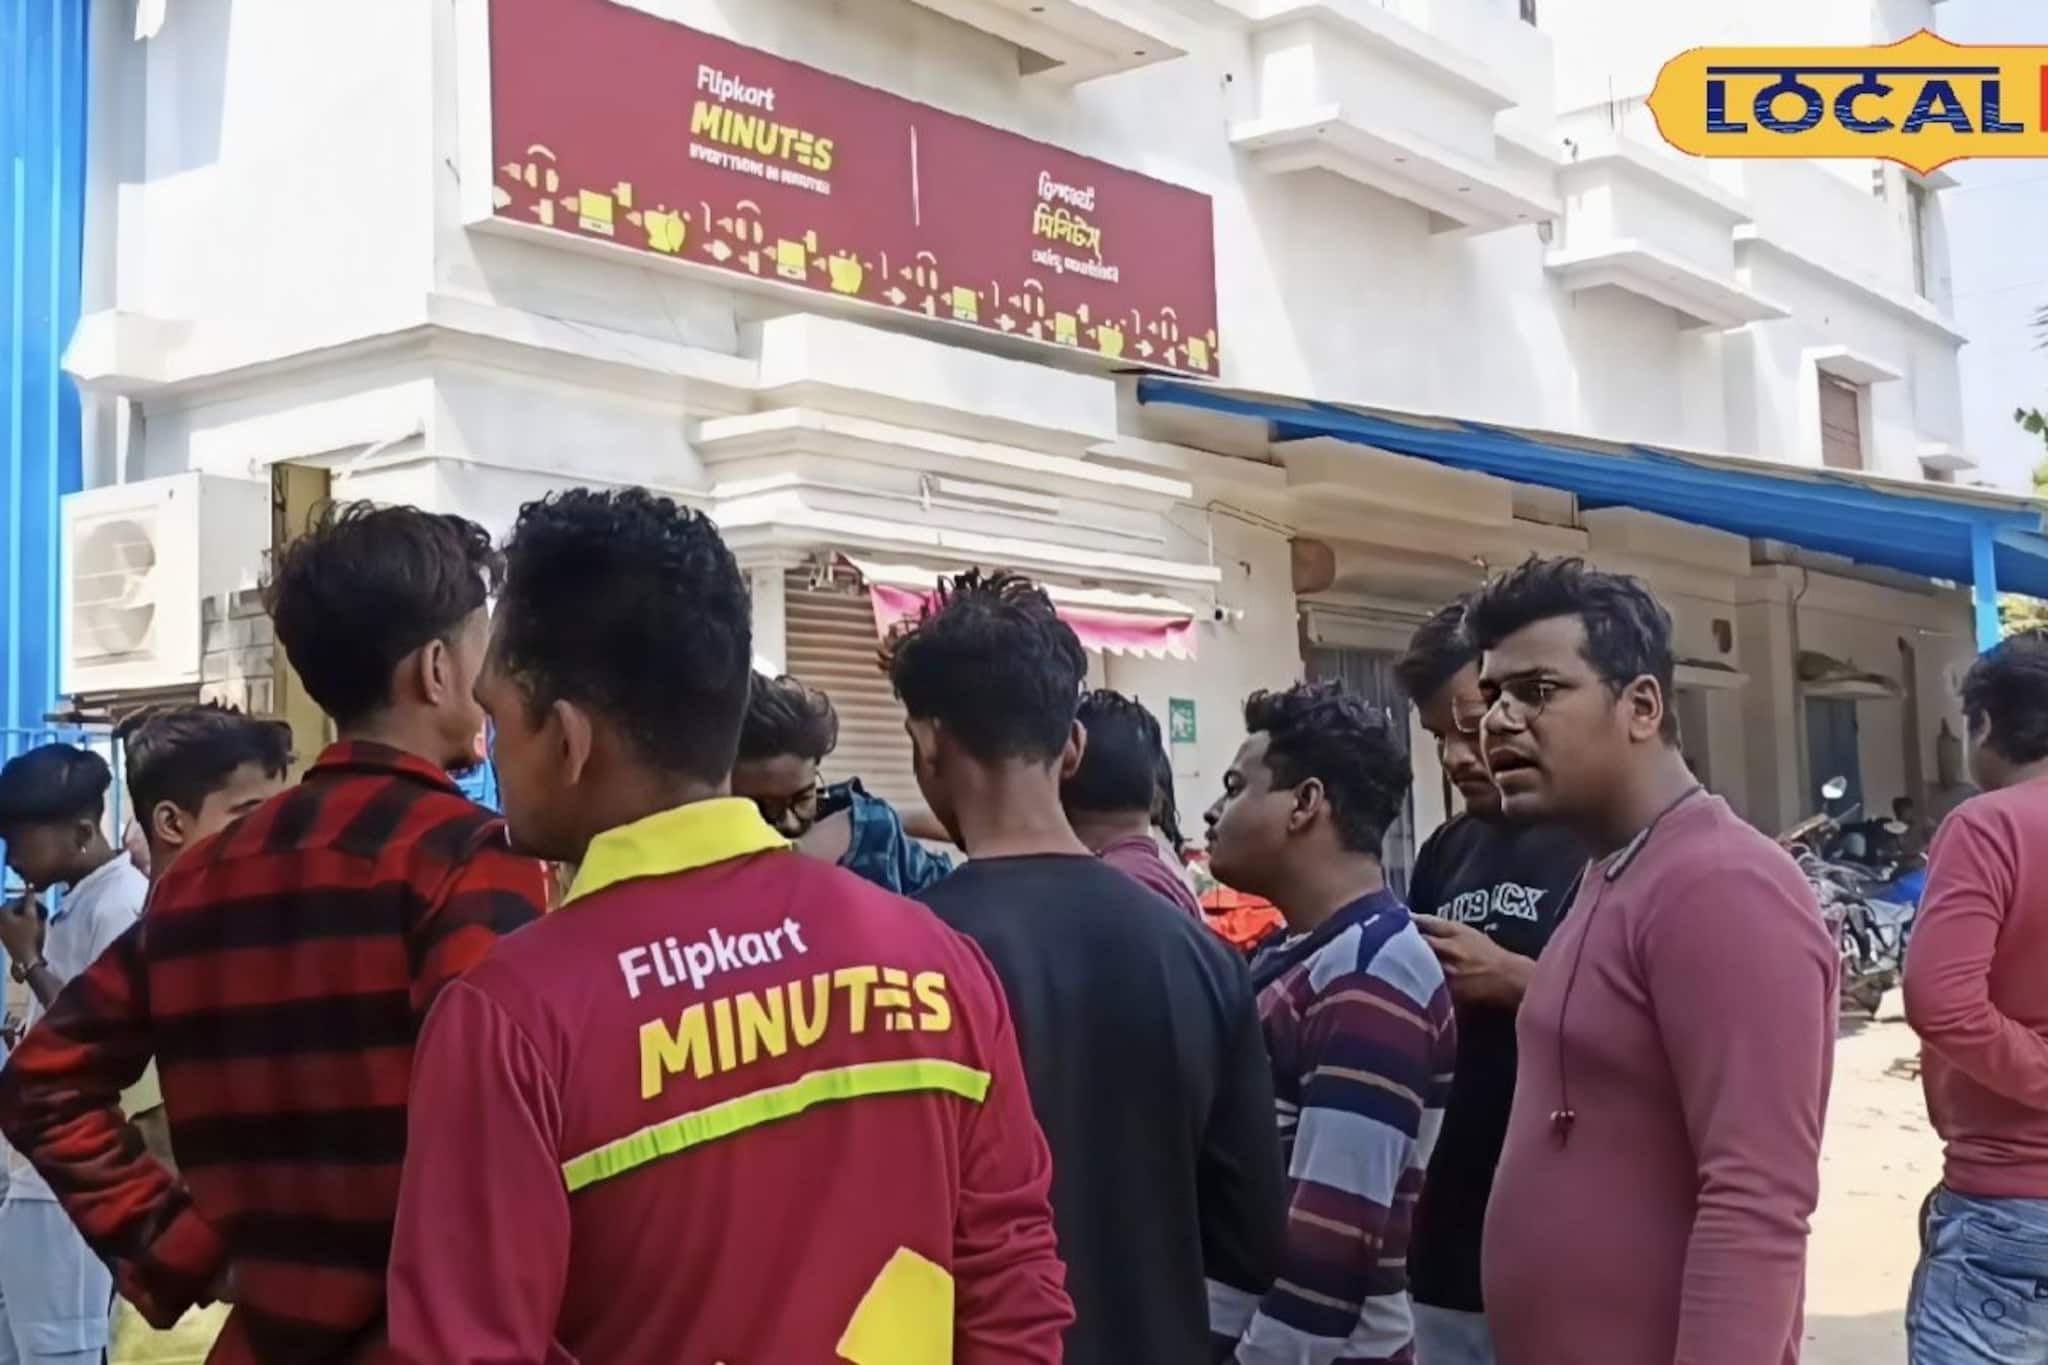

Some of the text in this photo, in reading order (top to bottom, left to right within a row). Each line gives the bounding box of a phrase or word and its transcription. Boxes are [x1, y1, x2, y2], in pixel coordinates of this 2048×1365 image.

[697, 64, 775, 111] Flipkart
[691, 101, 834, 171] MINUTES
[618, 917, 808, 999] Flipkart
[639, 965, 951, 1100] MINUTES
